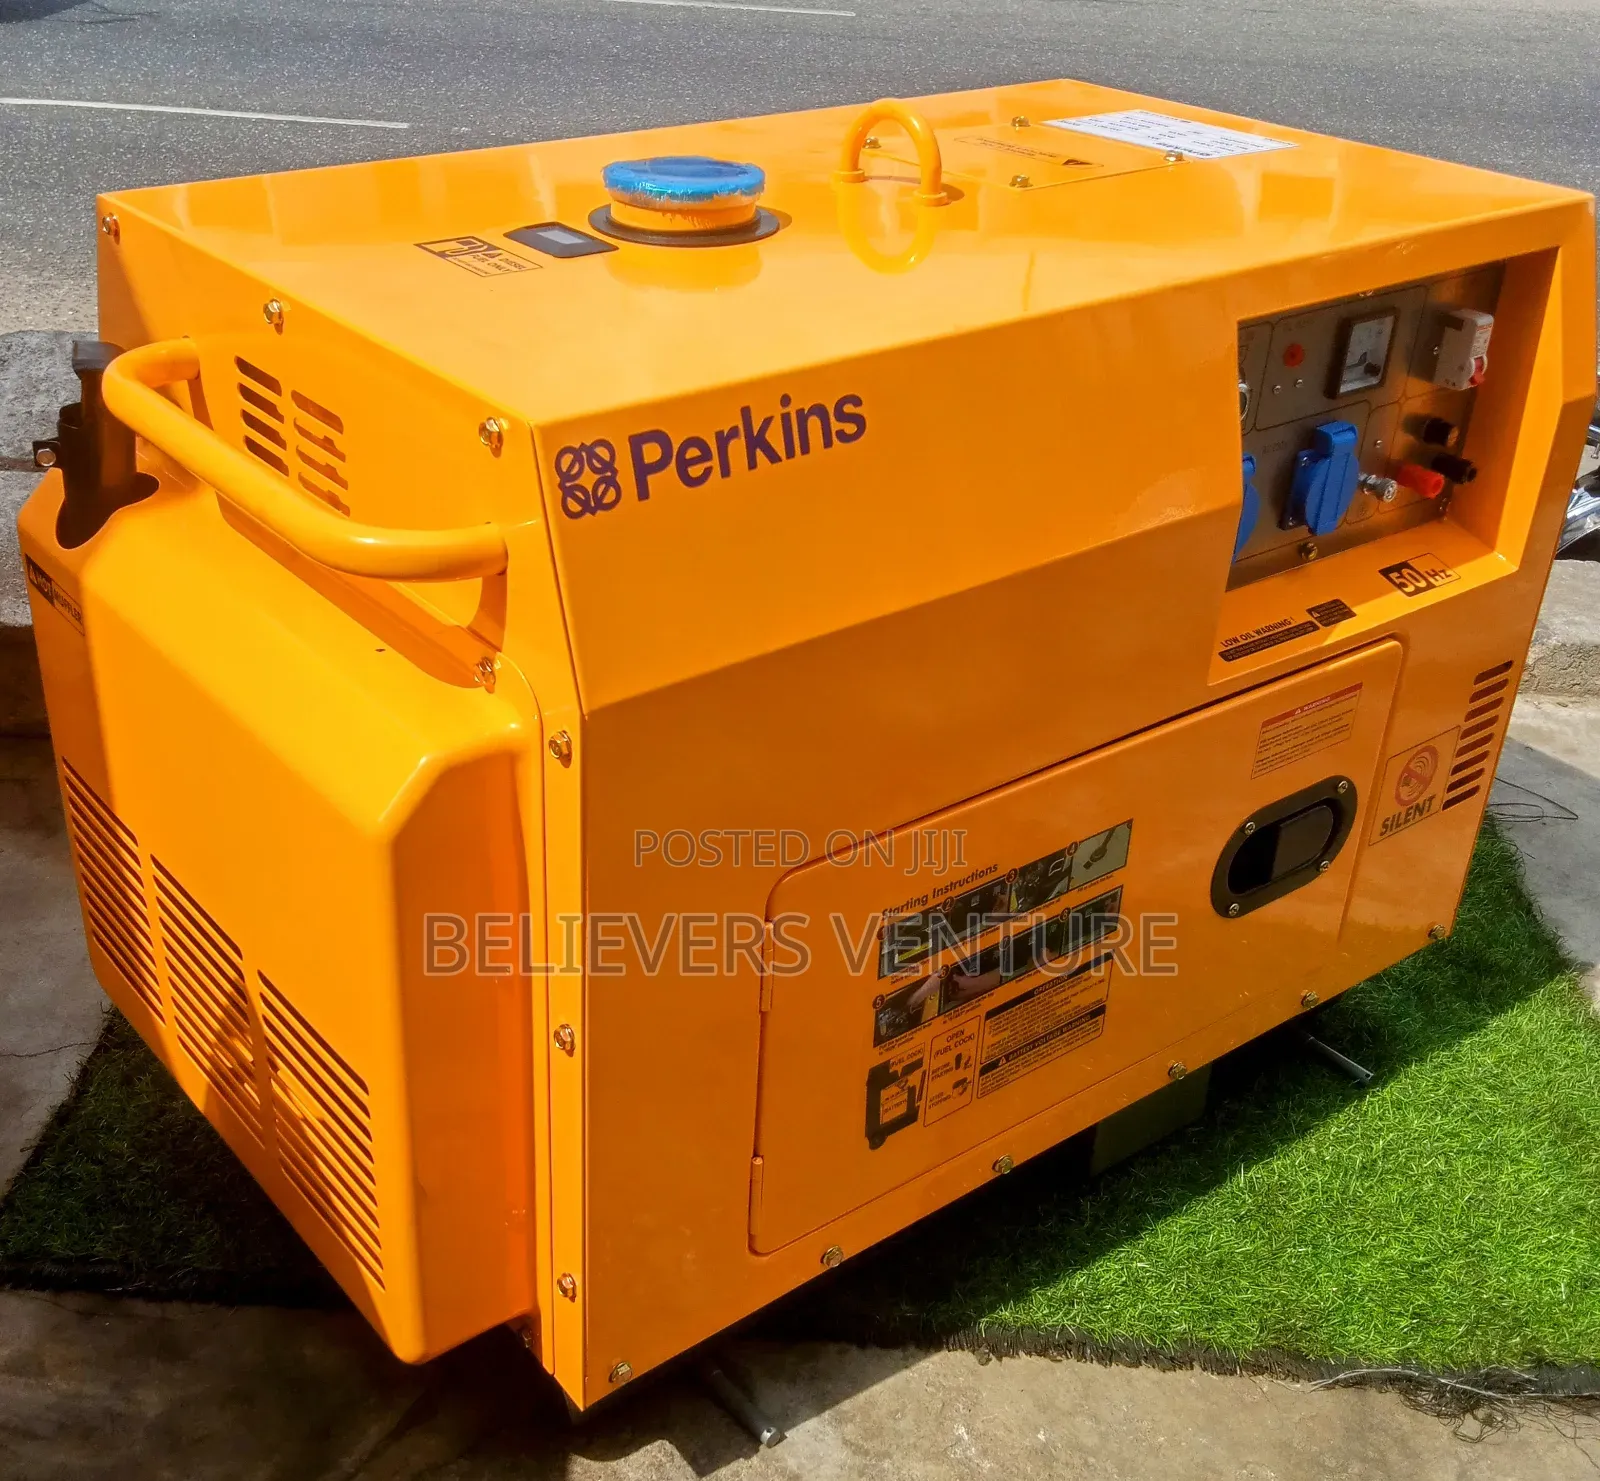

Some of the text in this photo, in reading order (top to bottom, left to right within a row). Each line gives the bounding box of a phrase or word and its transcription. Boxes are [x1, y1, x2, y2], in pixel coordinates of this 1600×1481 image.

[628, 393, 867, 502] Perkins
[1388, 567, 1453, 592] 50 Hz
[1220, 634, 1240, 648] LOW
[1239, 628, 1256, 643] OIL
[1254, 618, 1295, 639] WARNING
[1379, 795, 1436, 837] SILENT
[882, 863, 998, 919] Starting Instructions
[934, 1032, 975, 1060] (FUEL COCK)
[946, 1028, 965, 1043] OPEN
